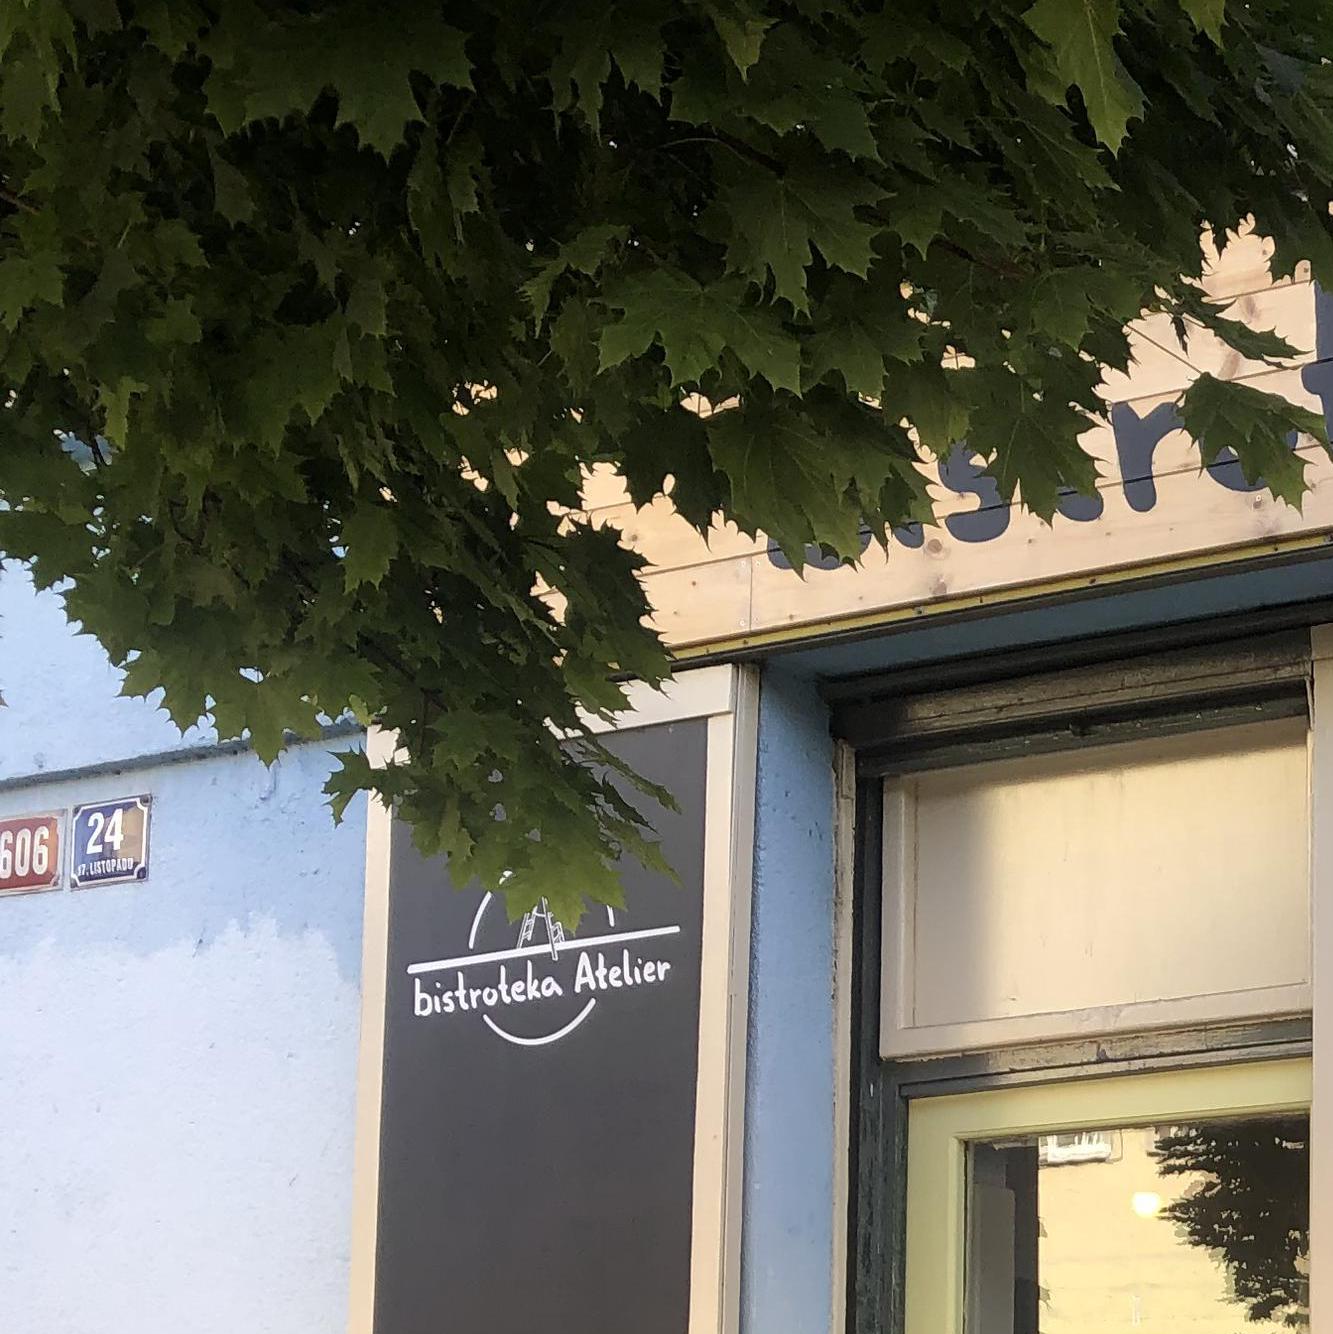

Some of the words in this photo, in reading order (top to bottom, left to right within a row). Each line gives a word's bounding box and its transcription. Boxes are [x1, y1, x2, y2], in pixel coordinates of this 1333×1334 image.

[0, 825, 50, 879] 606
[86, 808, 125, 855] 24
[414, 959, 564, 1017] bistroteka
[574, 948, 672, 994] Atelier
